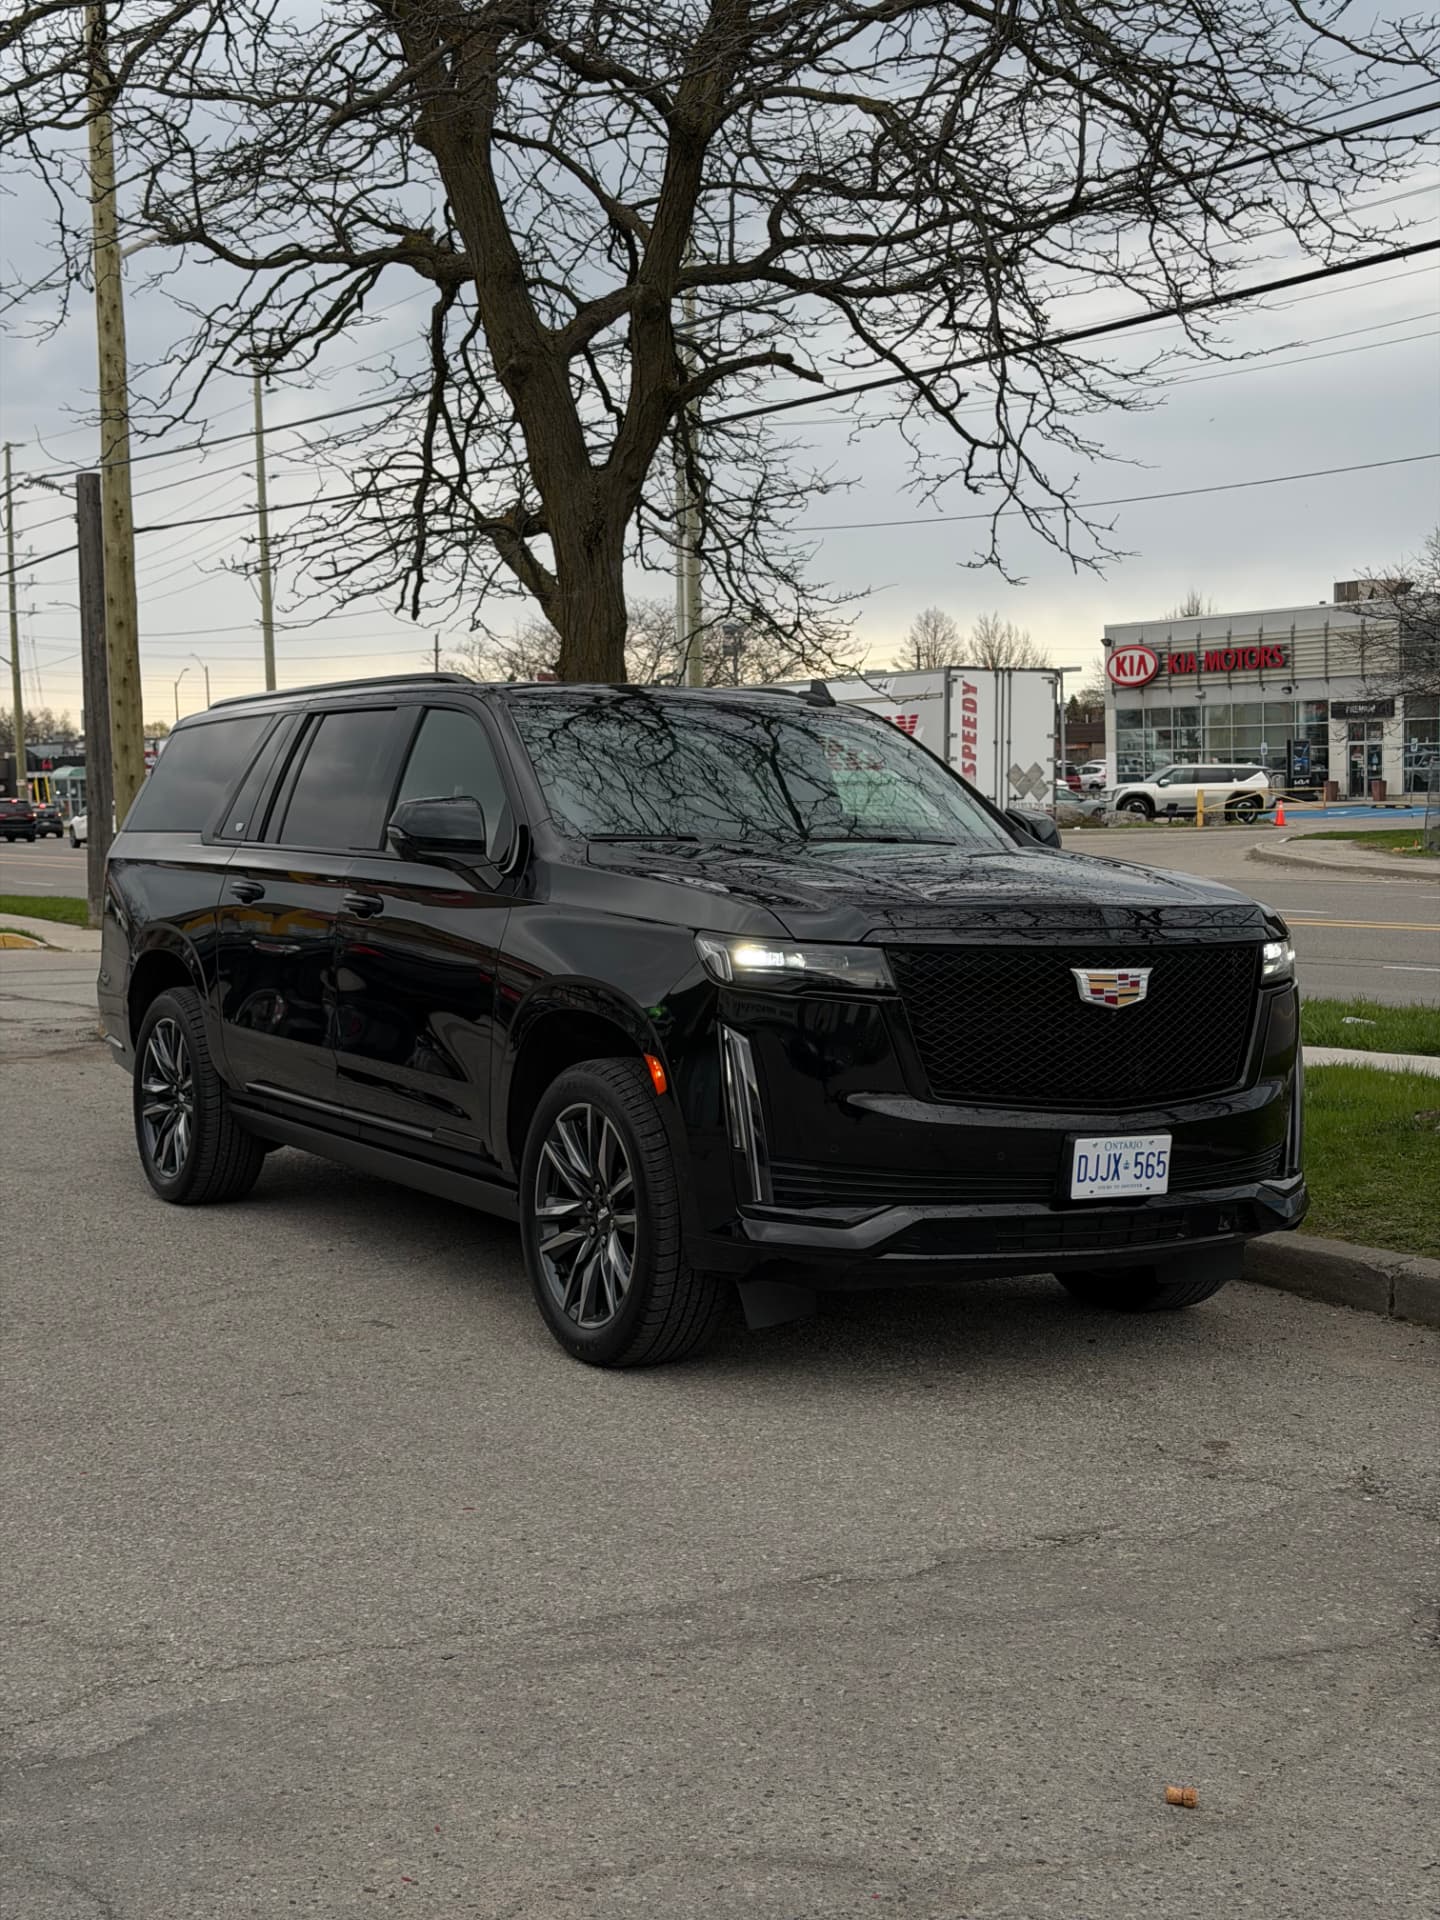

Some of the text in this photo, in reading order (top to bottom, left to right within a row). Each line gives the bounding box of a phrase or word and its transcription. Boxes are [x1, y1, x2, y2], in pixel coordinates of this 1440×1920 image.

[1115, 654, 1149, 677] KIA
[1167, 645, 1285, 674] KIA MOTORS
[962, 680, 978, 778] SPEEDY
[1104, 1140, 1143, 1151] ONTARIO
[1077, 1151, 1168, 1183] DJJX 565
